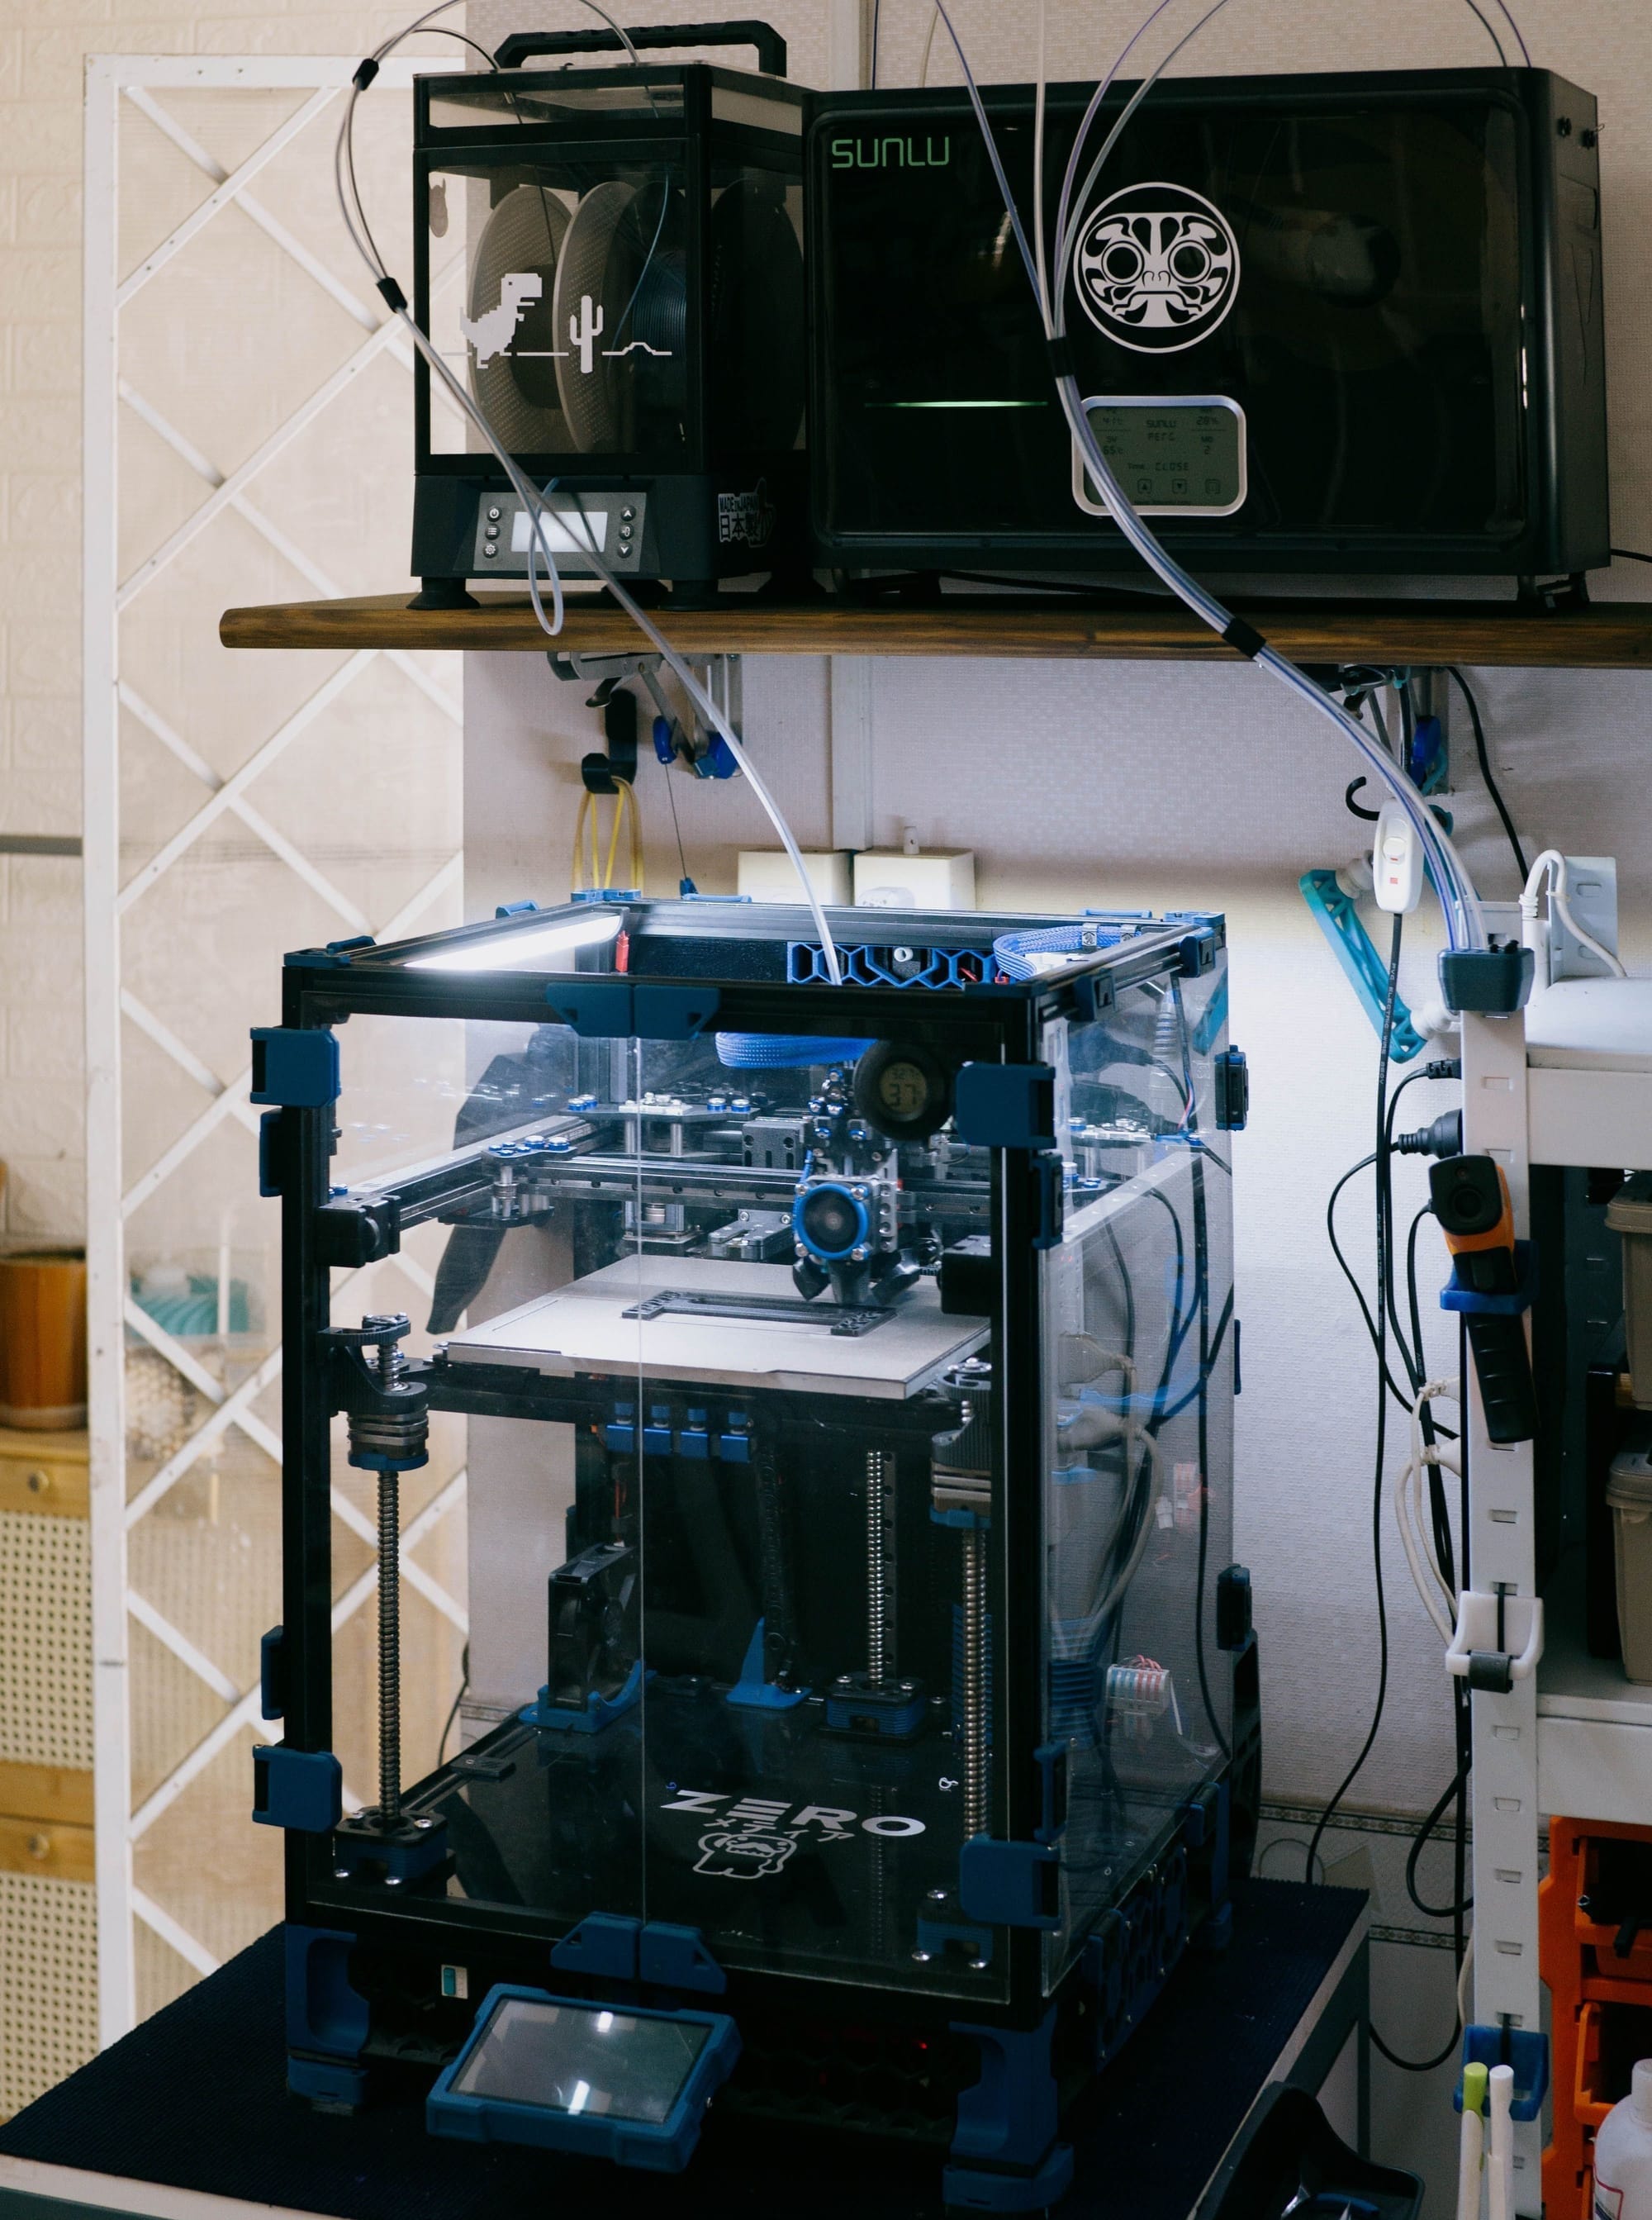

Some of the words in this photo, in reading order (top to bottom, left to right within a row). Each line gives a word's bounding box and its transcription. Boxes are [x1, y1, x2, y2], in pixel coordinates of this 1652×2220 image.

[832, 136, 949, 168] SUNLU
[1156, 462, 1189, 471] CLOSE
[703, 1818, 856, 1842] メディア
